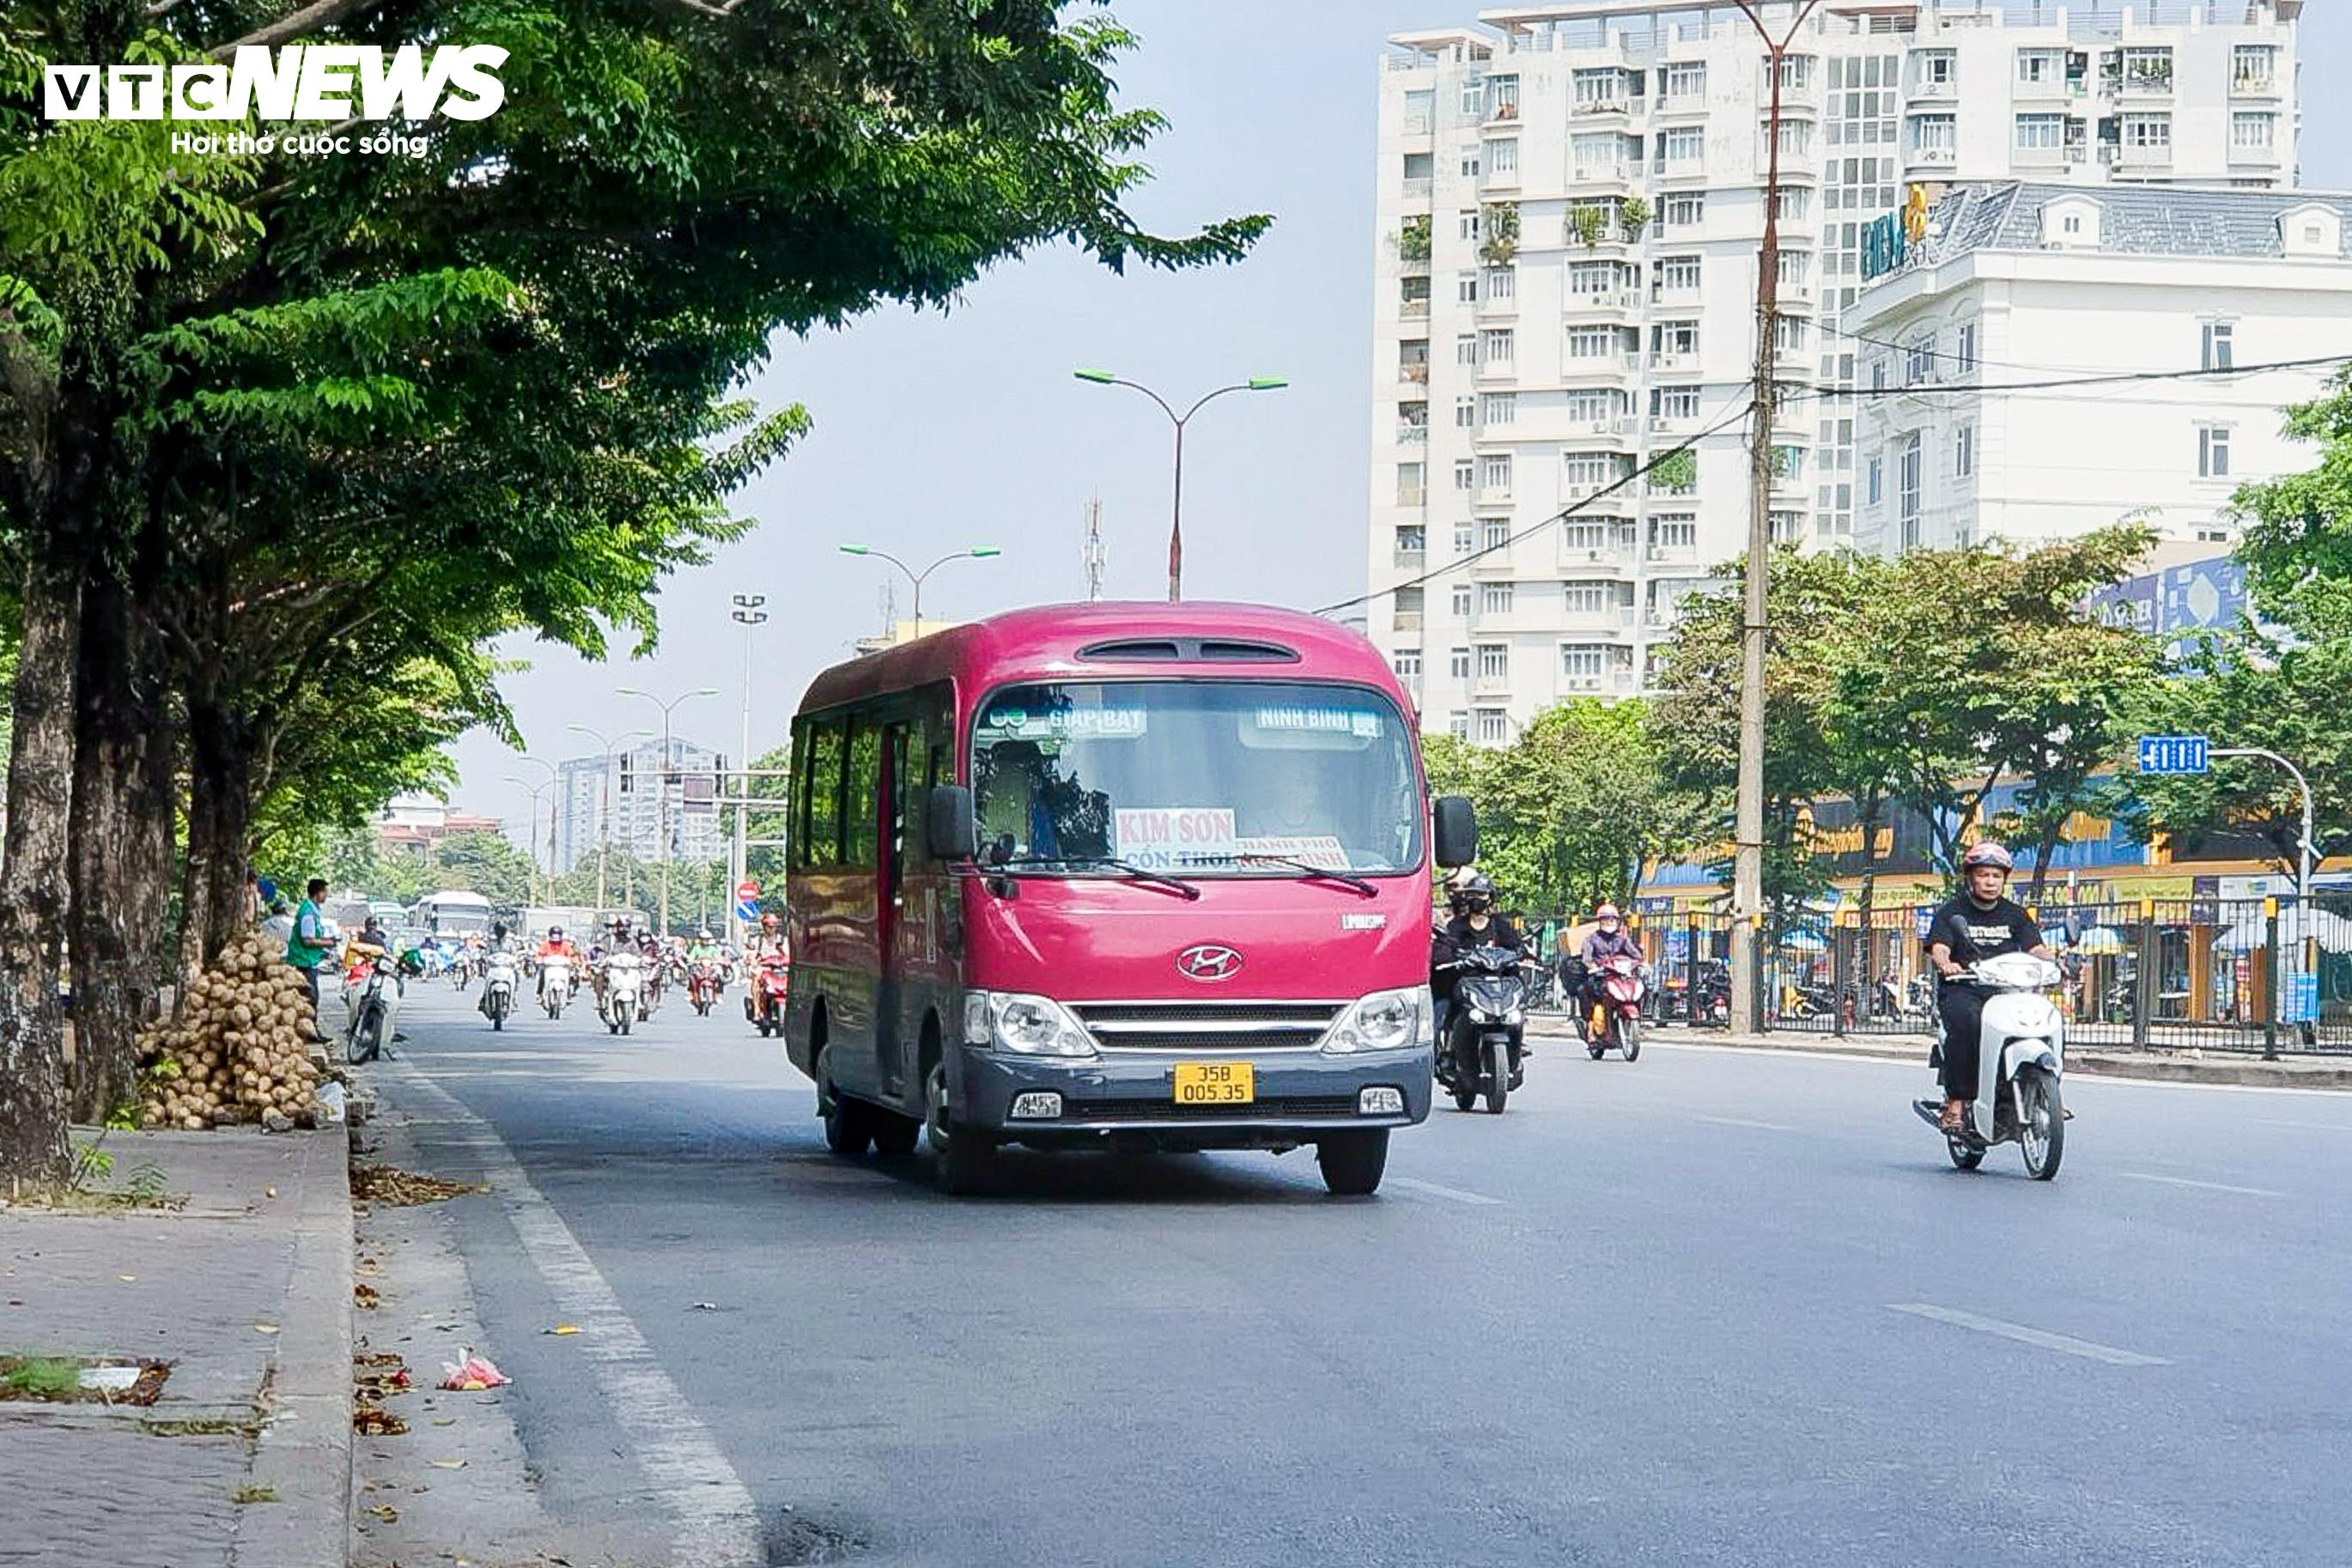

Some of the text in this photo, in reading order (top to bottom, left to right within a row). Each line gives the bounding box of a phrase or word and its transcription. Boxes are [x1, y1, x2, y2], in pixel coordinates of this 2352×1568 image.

[1119, 811, 1170, 843] KIM
[1197, 1066, 1231, 1082] 35B
[1183, 1084, 1245, 1101] 005.35
